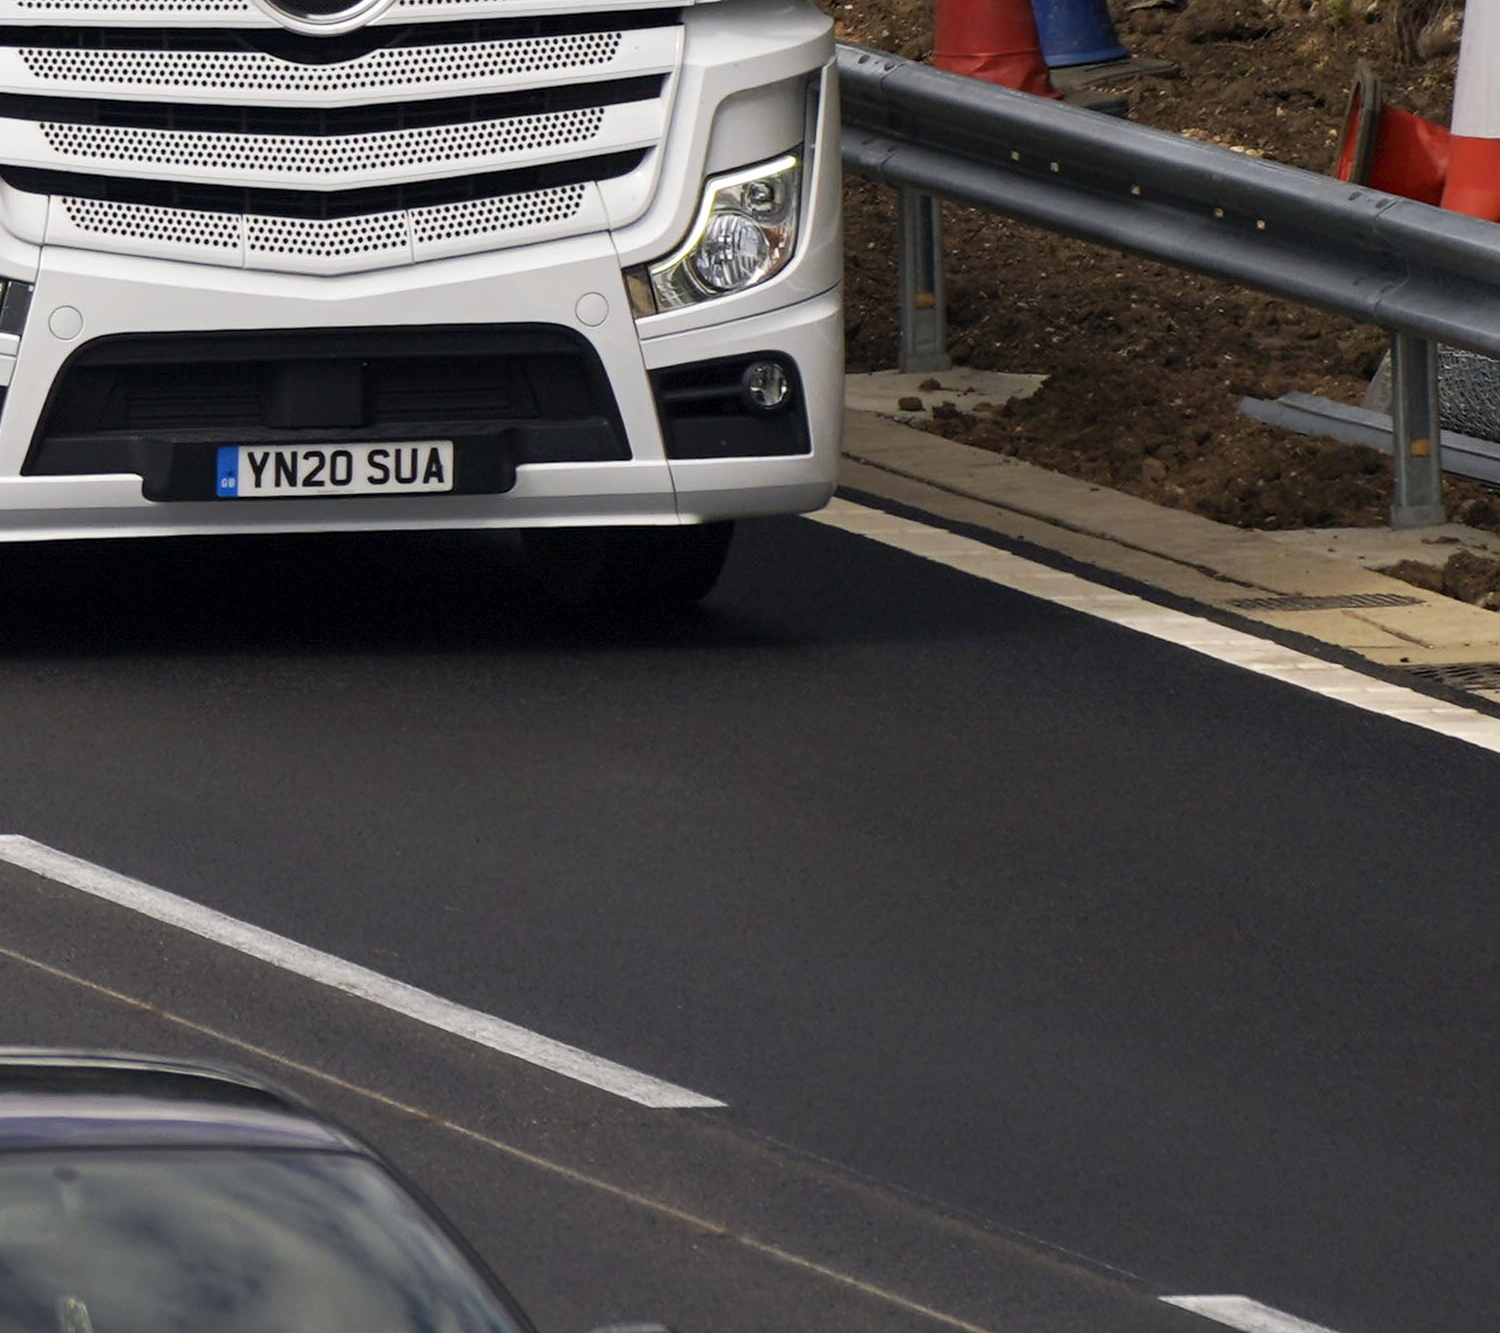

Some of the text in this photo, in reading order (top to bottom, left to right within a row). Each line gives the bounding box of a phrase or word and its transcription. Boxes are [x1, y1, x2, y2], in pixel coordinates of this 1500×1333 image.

[247, 447, 444, 488] YN20 SUA
[220, 477, 236, 489] GB
